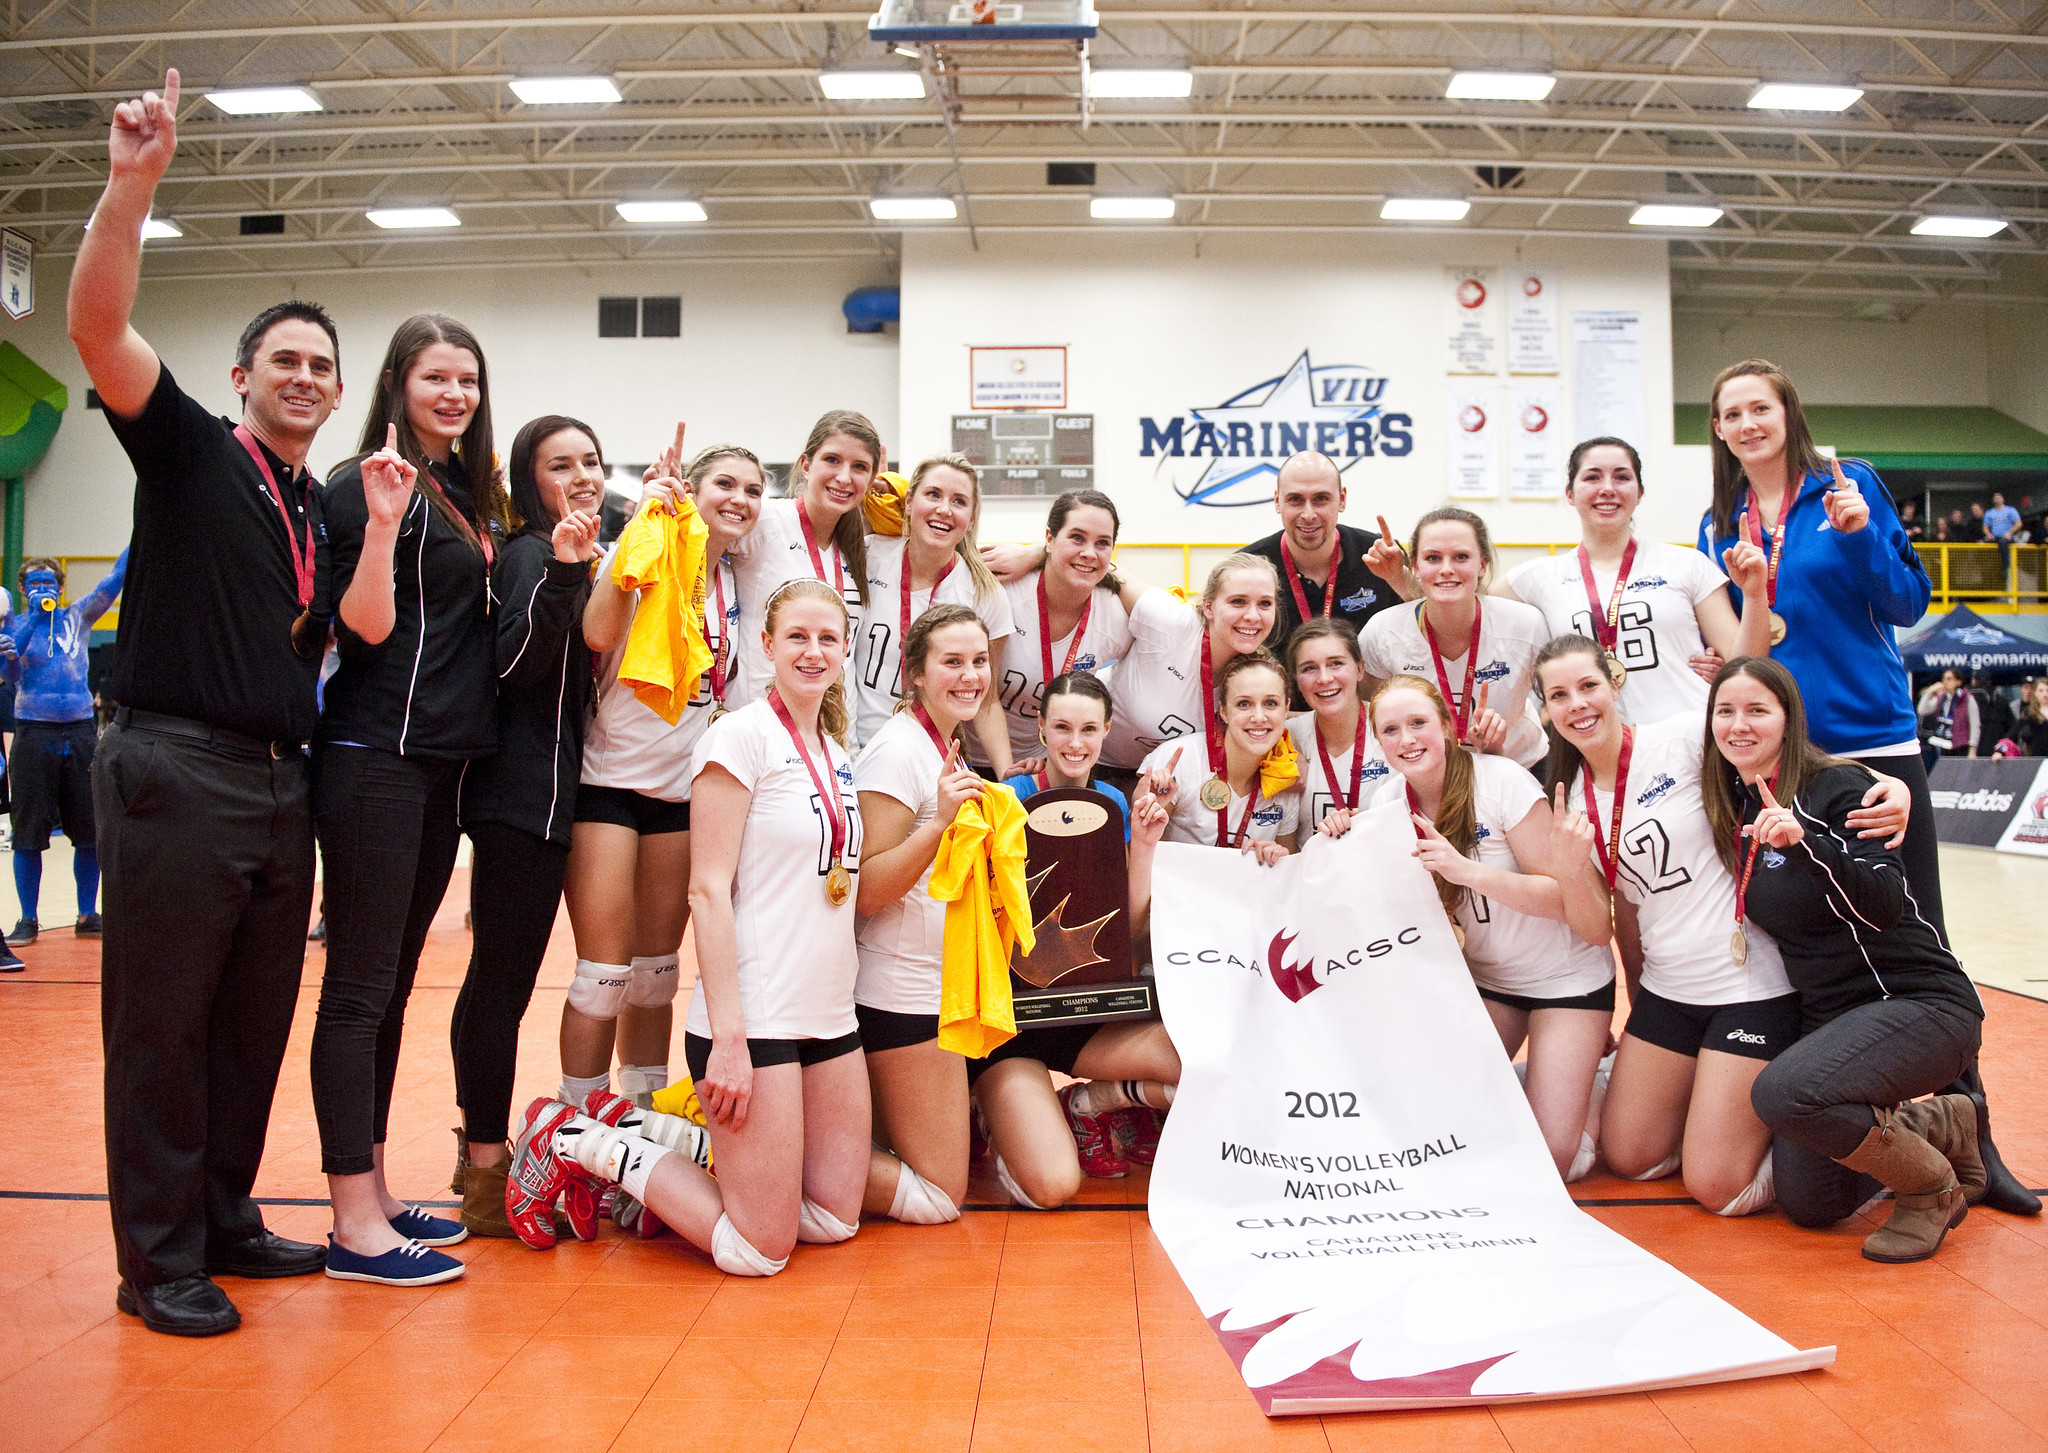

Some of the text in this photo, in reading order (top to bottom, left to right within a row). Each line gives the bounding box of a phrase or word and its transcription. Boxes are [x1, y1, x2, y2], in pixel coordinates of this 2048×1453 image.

[1321, 378, 1389, 402] VIU
[956, 419, 988, 430] HOME
[1056, 418, 1092, 429] GUEST
[1139, 413, 1413, 457] MARINERS
[1008, 469, 1039, 478] PLAYER
[1924, 652, 2048, 670] www.gomarine
[1957, 789, 2014, 812] adidas
[1610, 806, 1622, 865] VOLLEYBALL 2012
[1167, 927, 1421, 978] CCAA ACSC
[1062, 997, 1099, 1006] CHAMPIONS
[1285, 1091, 1360, 1118] 2012
[1221, 1134, 1467, 1173] WOMEN'S VOLLEYBALL
[1284, 1178, 1404, 1200] NATIONAL
[1236, 1207, 1490, 1229] CHAMPIONS
[1306, 1231, 1463, 1246] CANADIENS
[1250, 1245, 1425, 1260] VOLLEYBALL
